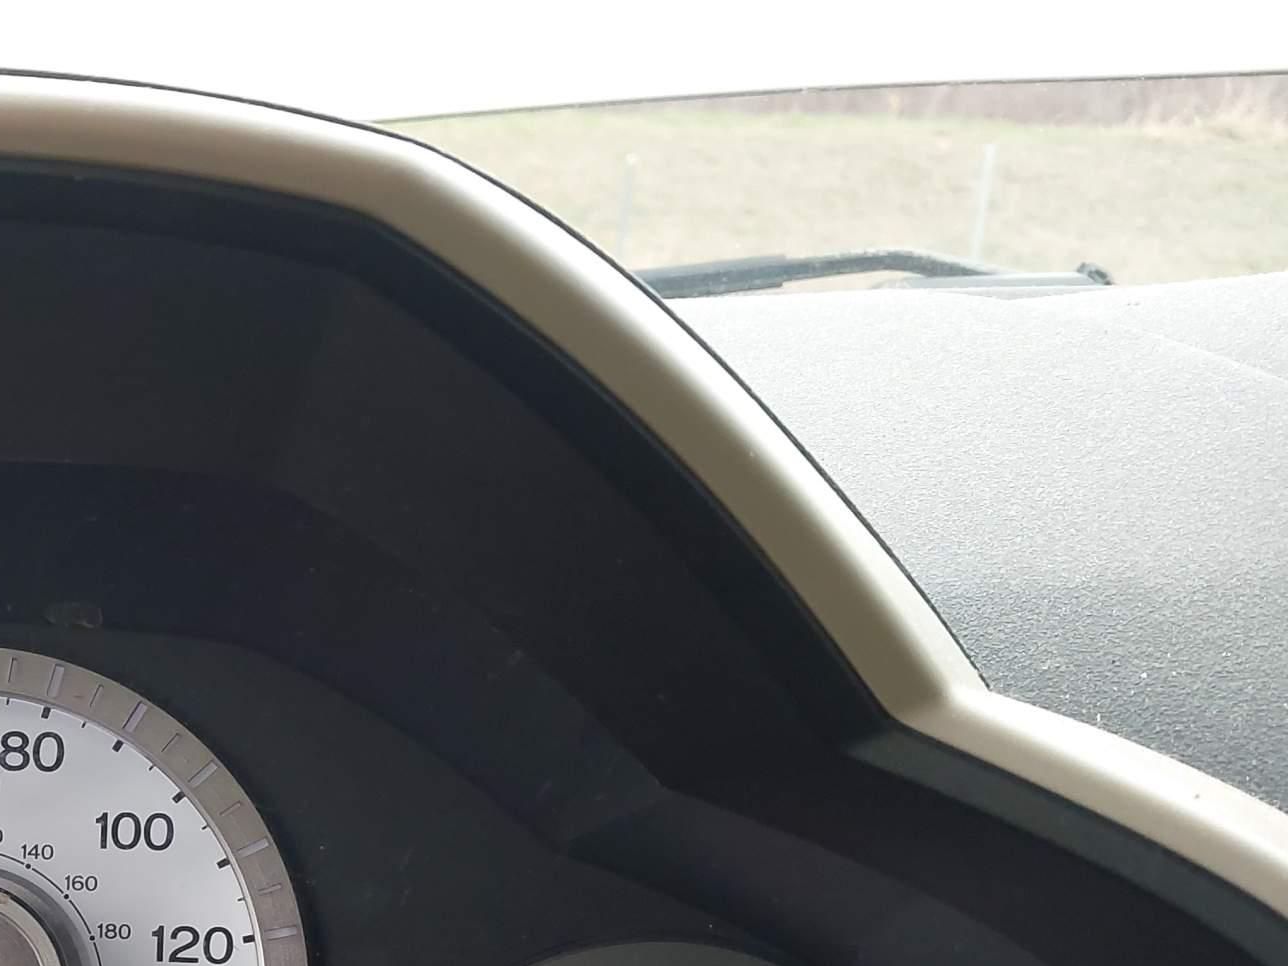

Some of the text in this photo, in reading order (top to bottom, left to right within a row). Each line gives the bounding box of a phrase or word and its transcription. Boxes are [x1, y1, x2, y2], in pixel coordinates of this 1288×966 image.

[96, 812, 174, 851] 100
[21, 844, 54, 860] 140
[64, 876, 98, 892] 160
[97, 923, 130, 939] 180
[152, 925, 234, 964] 120
